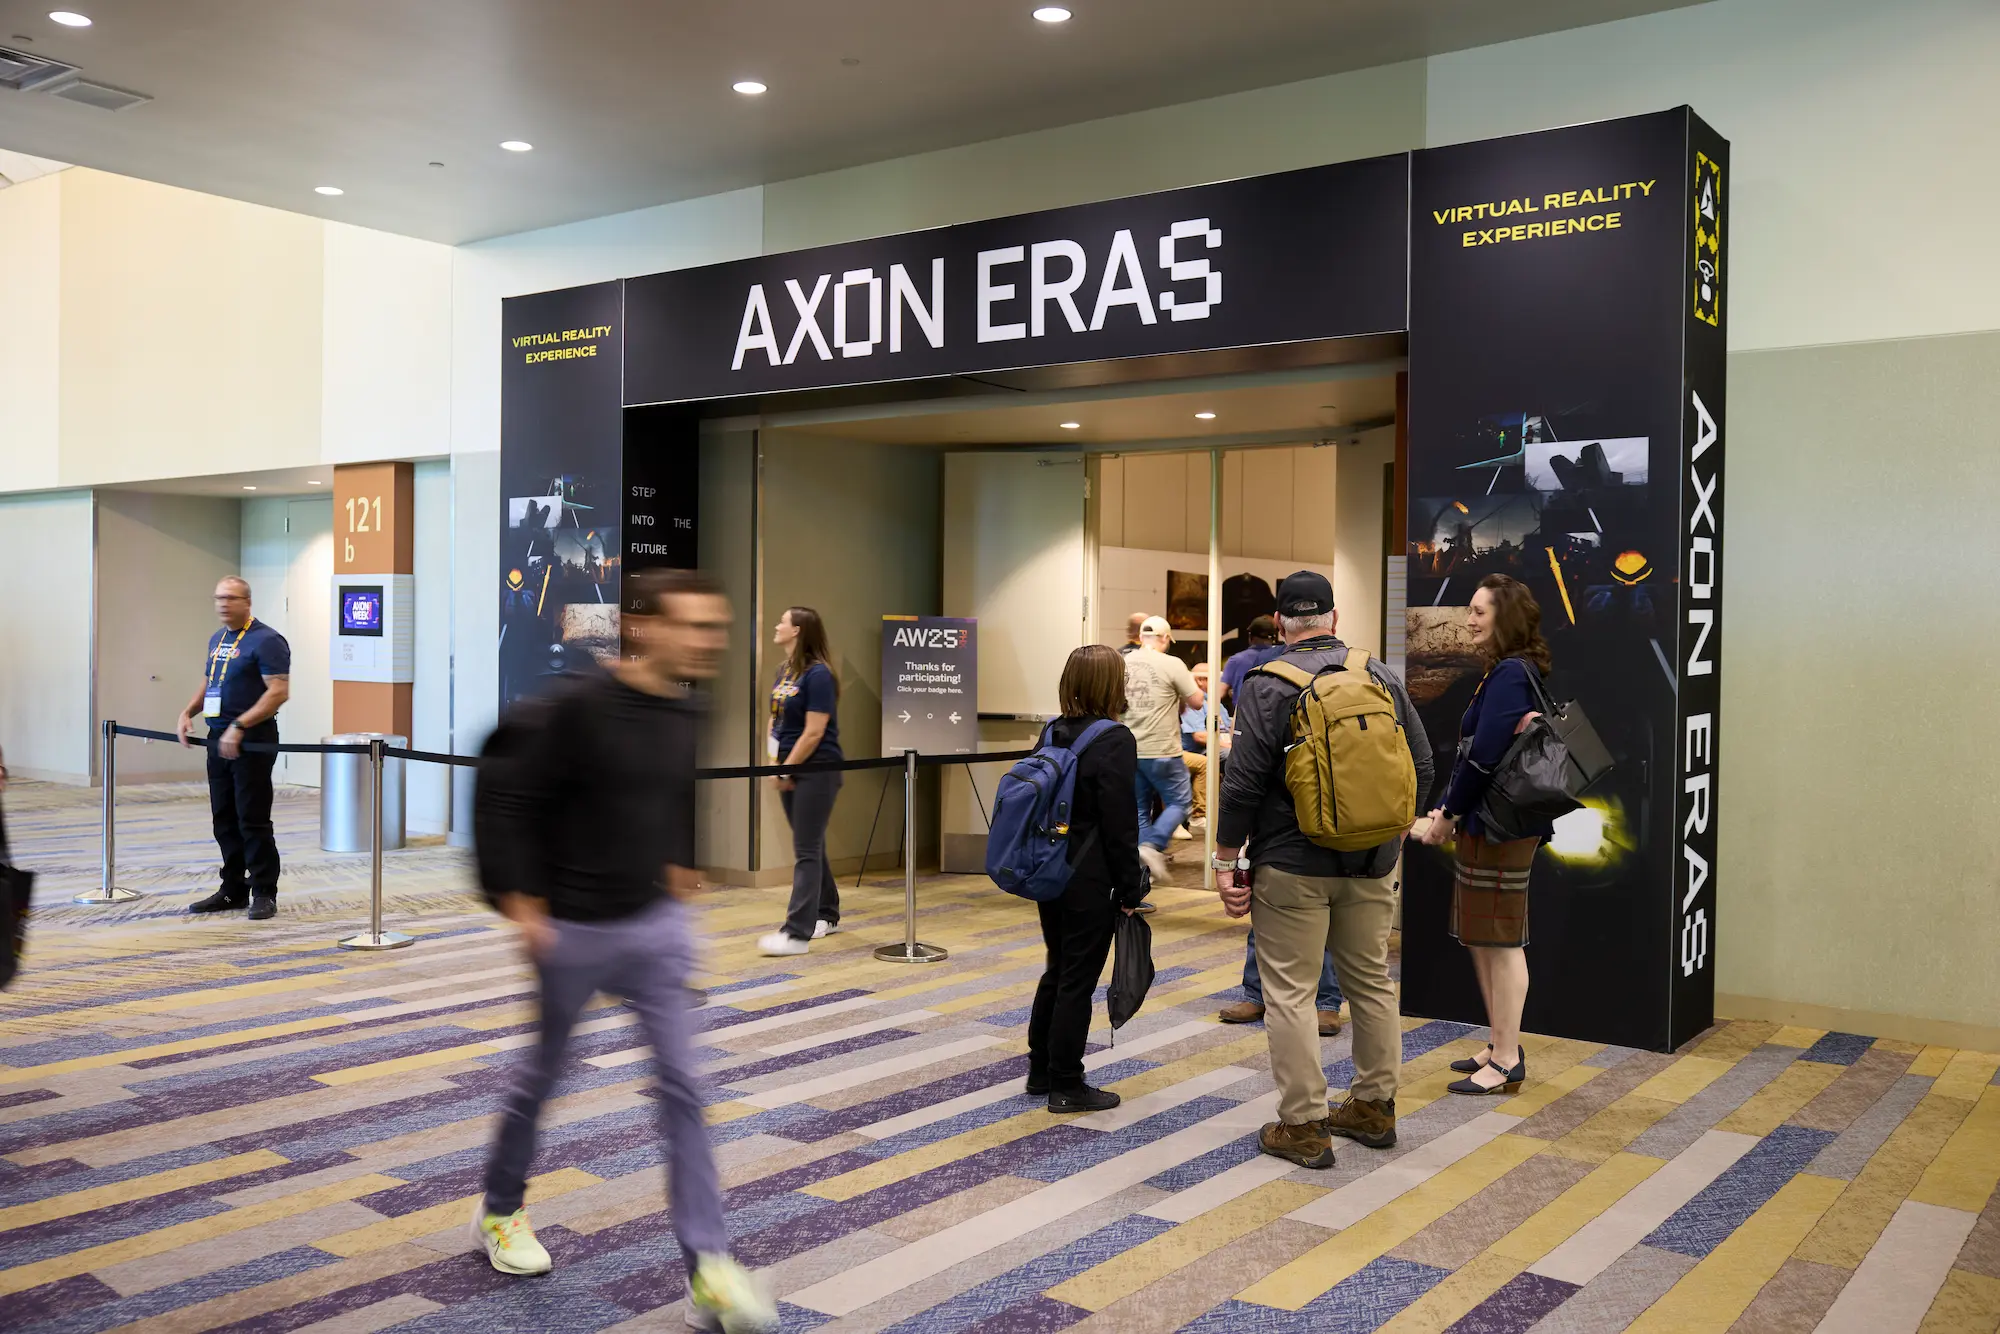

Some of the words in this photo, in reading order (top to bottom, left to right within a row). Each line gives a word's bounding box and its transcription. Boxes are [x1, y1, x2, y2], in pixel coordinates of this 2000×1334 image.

[1433, 197, 1540, 225] VIRTUAL
[1543, 180, 1656, 210] REALITY
[1462, 212, 1621, 247] EXPERIENCE
[731, 257, 945, 371] AXON
[977, 217, 1222, 344] ERAS
[512, 331, 561, 348] VIRTUAL
[562, 326, 612, 342] REALITY
[525, 345, 597, 364] EXPERIENCE
[631, 485, 656, 498] STEP
[345, 496, 381, 532] 121
[631, 514, 655, 527] INTO
[674, 517, 692, 530] THE
[1688, 391, 1717, 677] AXON
[344, 537, 355, 563] b
[631, 542, 668, 555] FUTURE
[893, 627, 958, 649] AW25
[905, 661, 939, 672] Thanks
[941, 662, 956, 672] for
[896, 685, 912, 693] Click
[912, 686, 927, 694] your
[928, 686, 947, 695] badge
[948, 686, 963, 694] here.
[898, 673, 962, 685] participating!
[1682, 712, 1712, 977] ERAS
